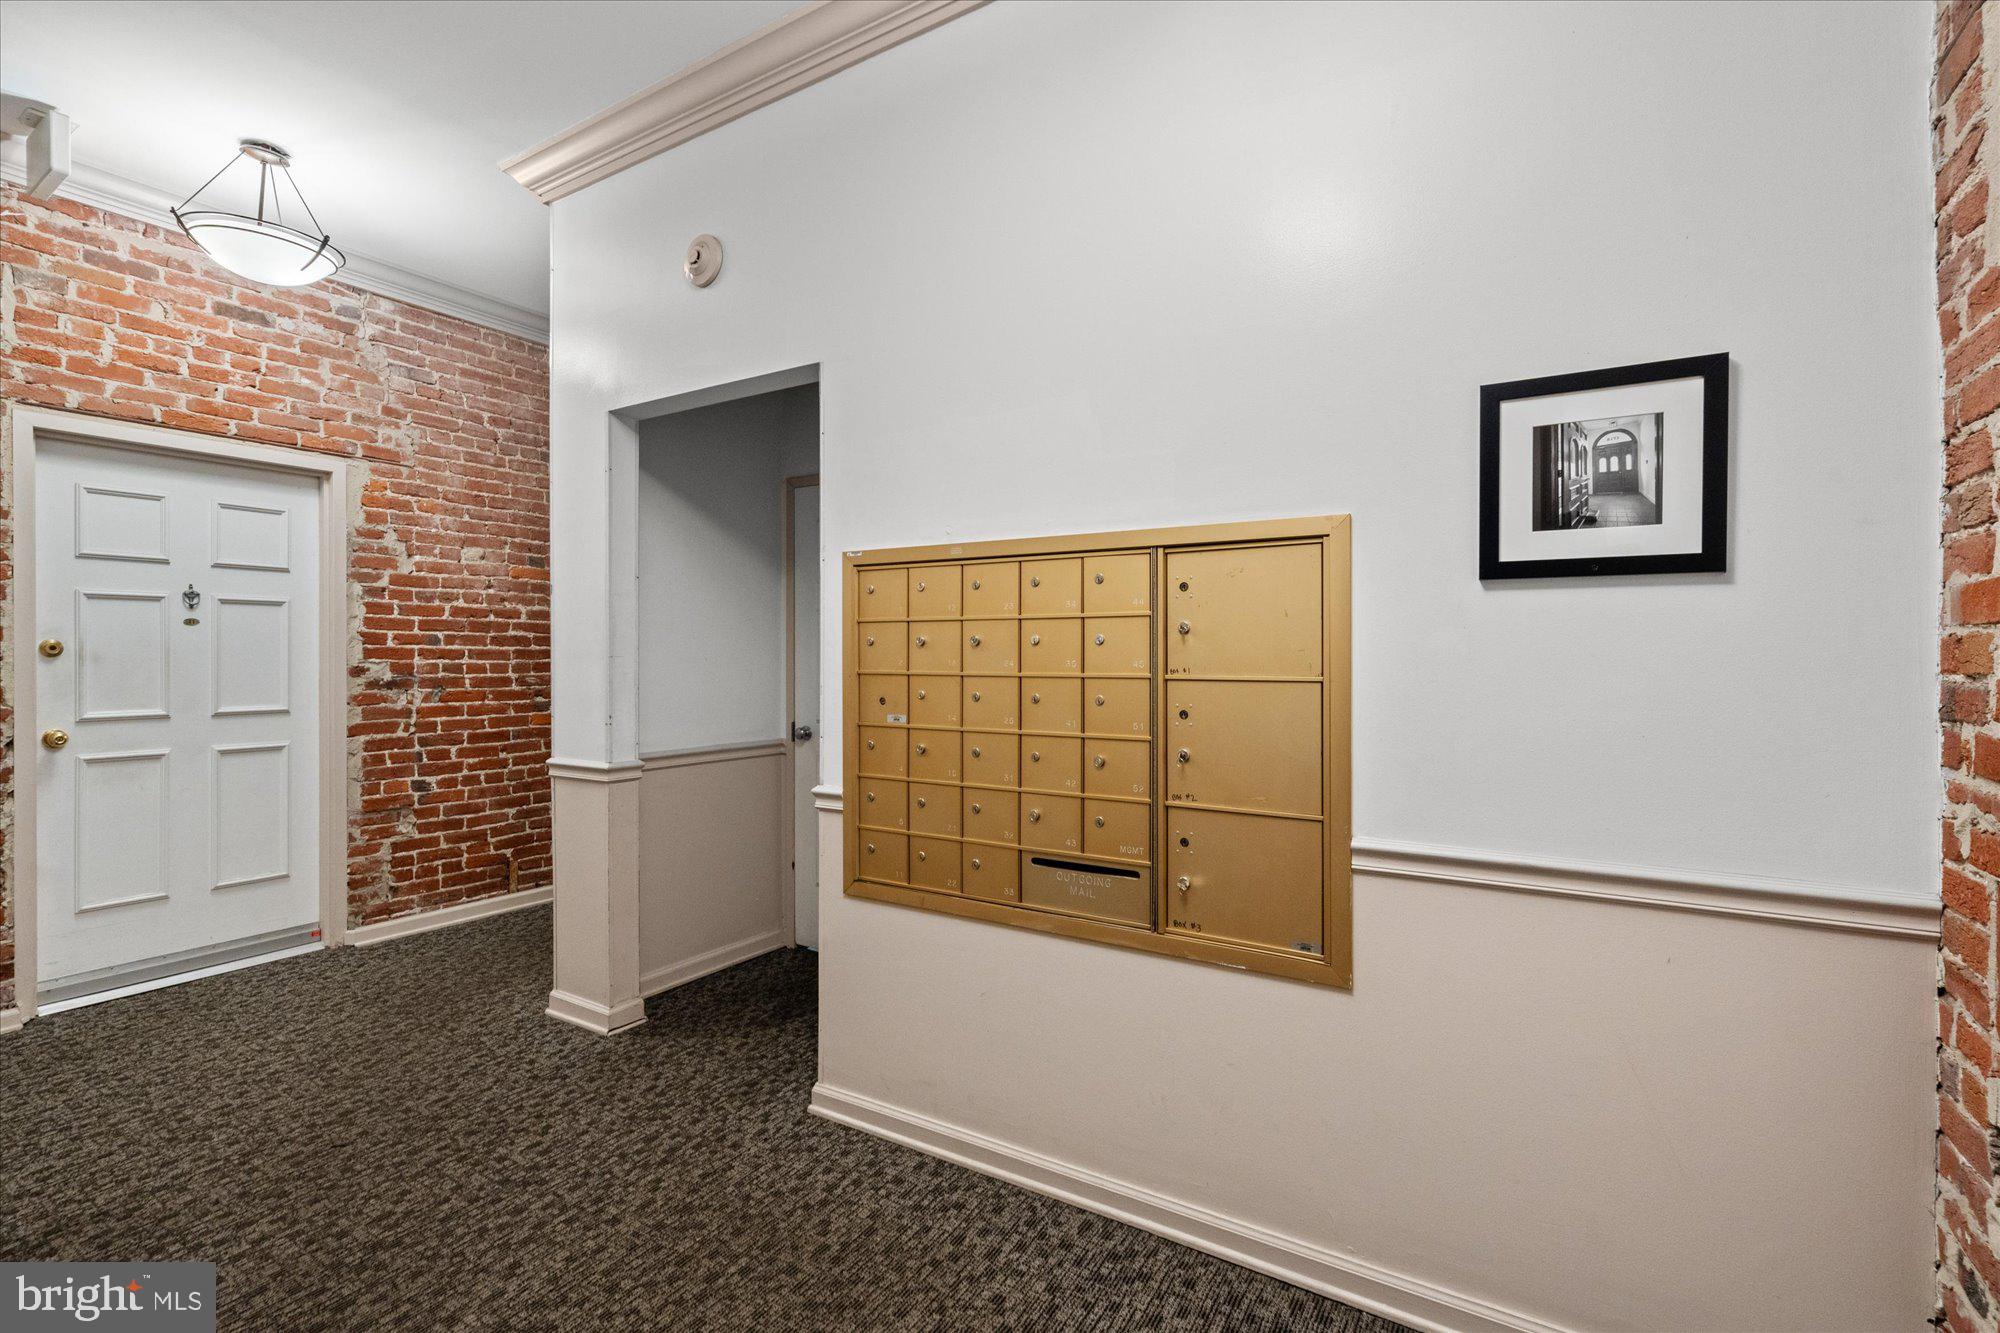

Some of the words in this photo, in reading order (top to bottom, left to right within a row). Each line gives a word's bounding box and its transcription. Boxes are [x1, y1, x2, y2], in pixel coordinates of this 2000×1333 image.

[1131, 784, 1144, 793] 52
[1065, 838, 1076, 847] 43
[1119, 845, 1144, 855] MGMT
[1056, 871, 1112, 888] OUTGOING
[1069, 886, 1095, 899] MAIL
